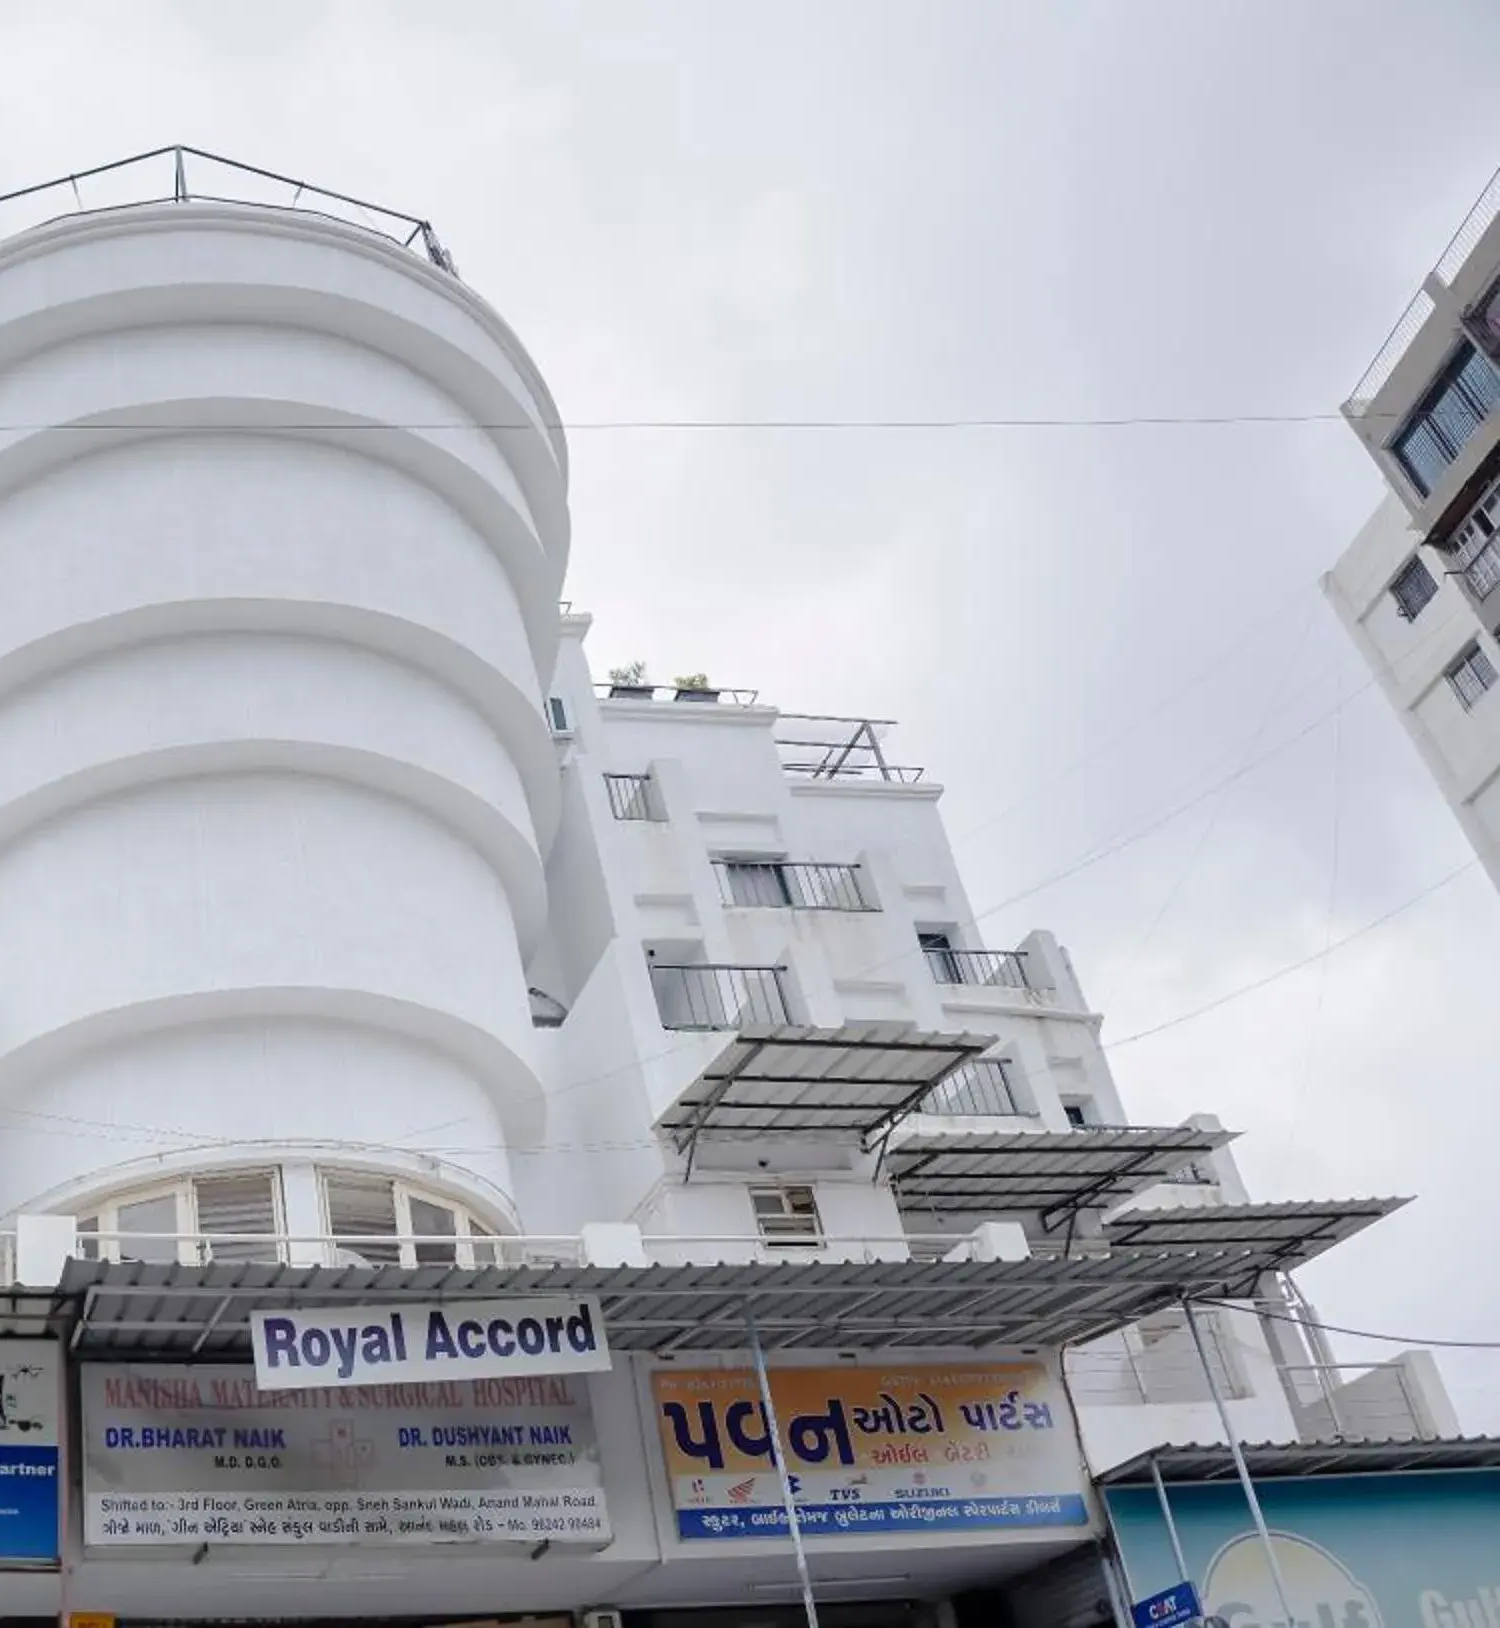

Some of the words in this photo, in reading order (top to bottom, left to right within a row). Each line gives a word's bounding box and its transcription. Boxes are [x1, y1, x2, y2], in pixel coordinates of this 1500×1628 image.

[263, 1312, 407, 1378] Royal
[425, 1303, 597, 1361] Accord
[105, 1378, 201, 1409] MANISHA
[472, 1375, 576, 1407] HOSPITAL
[105, 1427, 227, 1449] DR.BHARAT
[233, 1428, 286, 1448] NAIK
[398, 1427, 427, 1447] DR.
[432, 1425, 524, 1446] DUSHYANT
[529, 1424, 573, 1445] NAIK
[663, 1398, 855, 1469] પવન
[853, 1392, 945, 1433] ઓટો
[445, 1454, 470, 1467] M.S.
[101, 1499, 148, 1513] Shifted
[179, 1498, 199, 1512] 3rd
[244, 1498, 282, 1512] Green
[357, 1498, 389, 1511] Sneh
[829, 1488, 861, 1500] TVS
[1216, 1600, 1367, 1628] Glf
